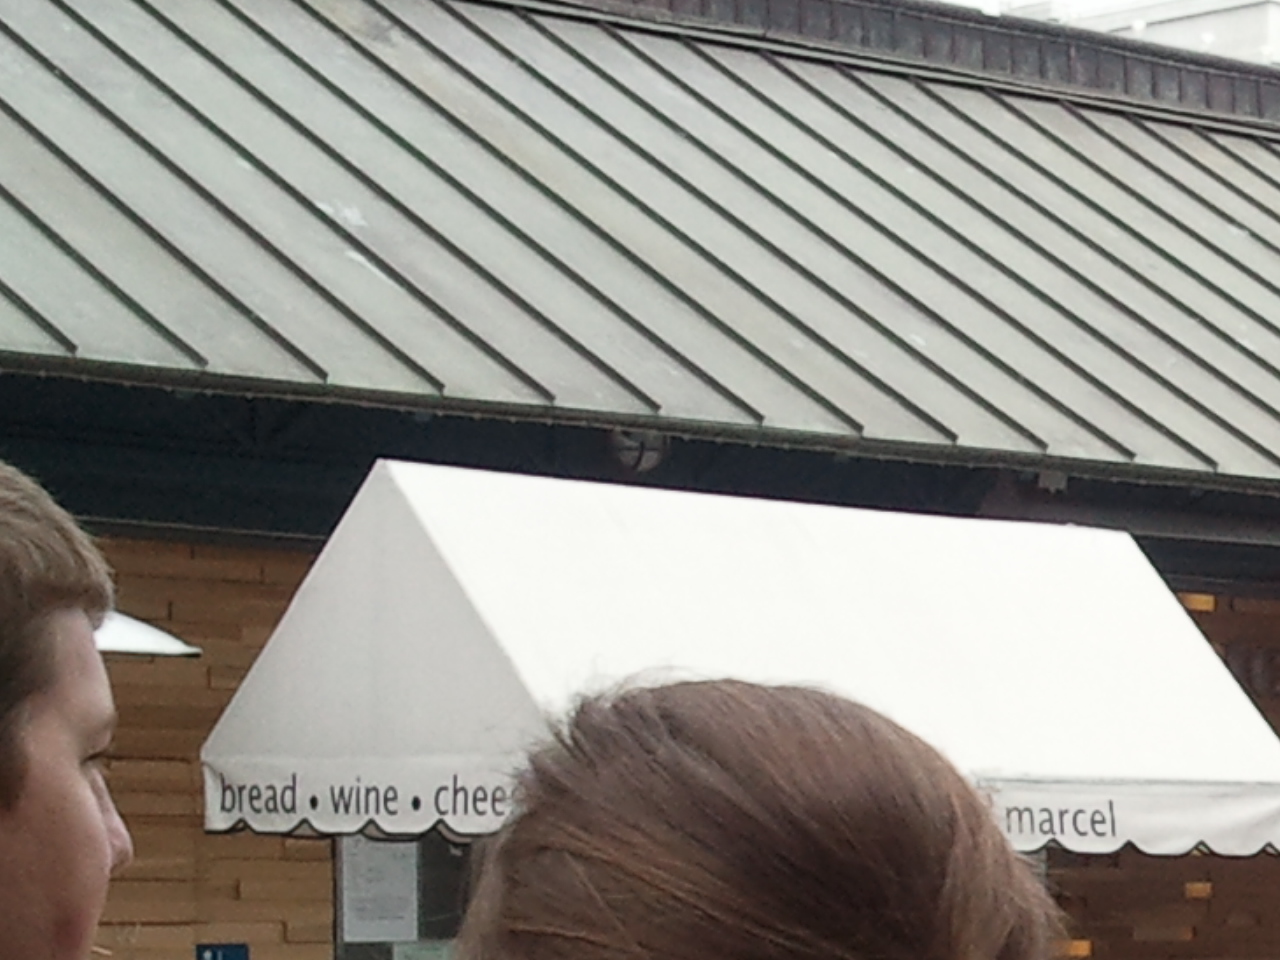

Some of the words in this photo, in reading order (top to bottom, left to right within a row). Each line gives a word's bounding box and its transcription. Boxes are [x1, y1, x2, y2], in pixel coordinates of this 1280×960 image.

[219, 772, 297, 814] bread
[330, 775, 399, 816] wine
[1005, 800, 1117, 837] marcel
